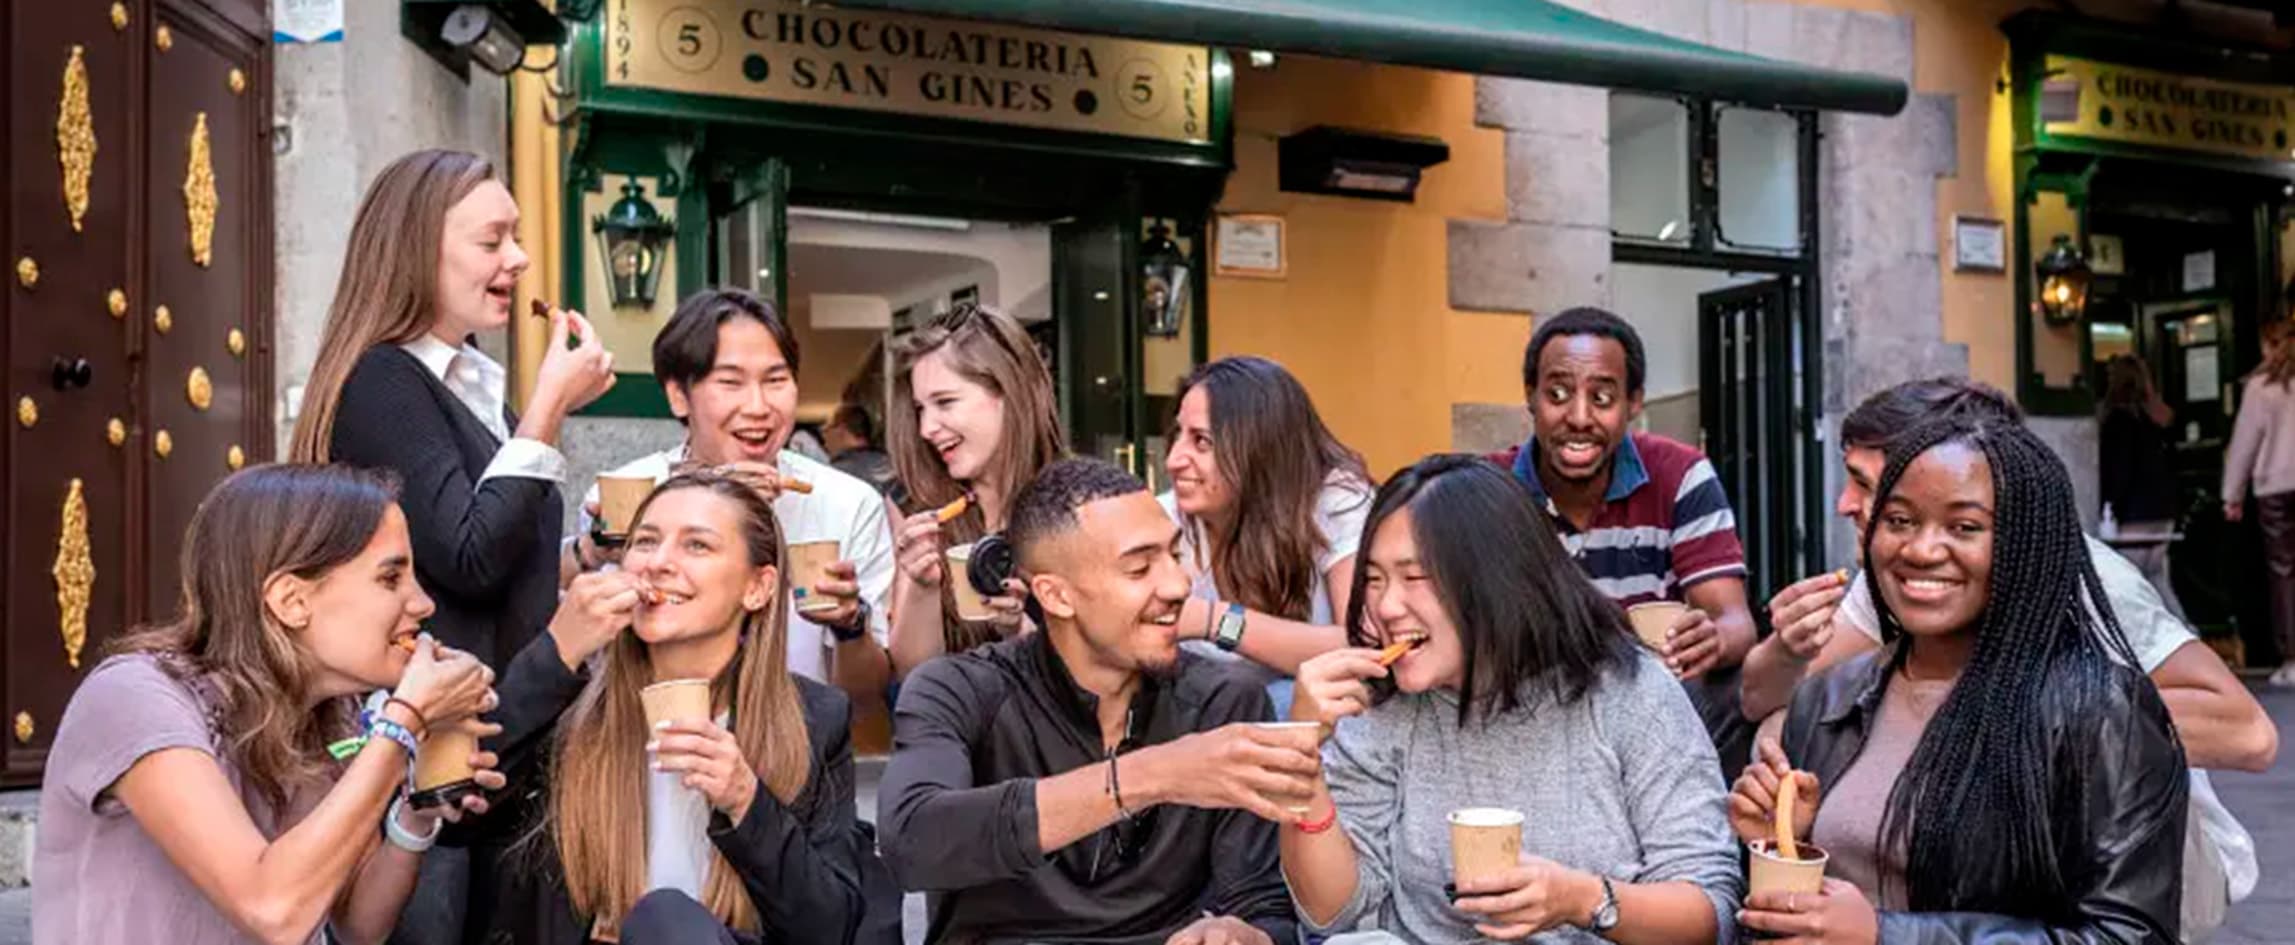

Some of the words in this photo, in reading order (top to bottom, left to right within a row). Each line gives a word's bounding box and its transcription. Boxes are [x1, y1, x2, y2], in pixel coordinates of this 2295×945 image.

[678, 24, 701, 56] 5
[741, 9, 1098, 78] CHOCOLATERIA
[791, 56, 889, 97] SAN
[920, 71, 1052, 112] GINES
[1131, 74, 1153, 105] 5
